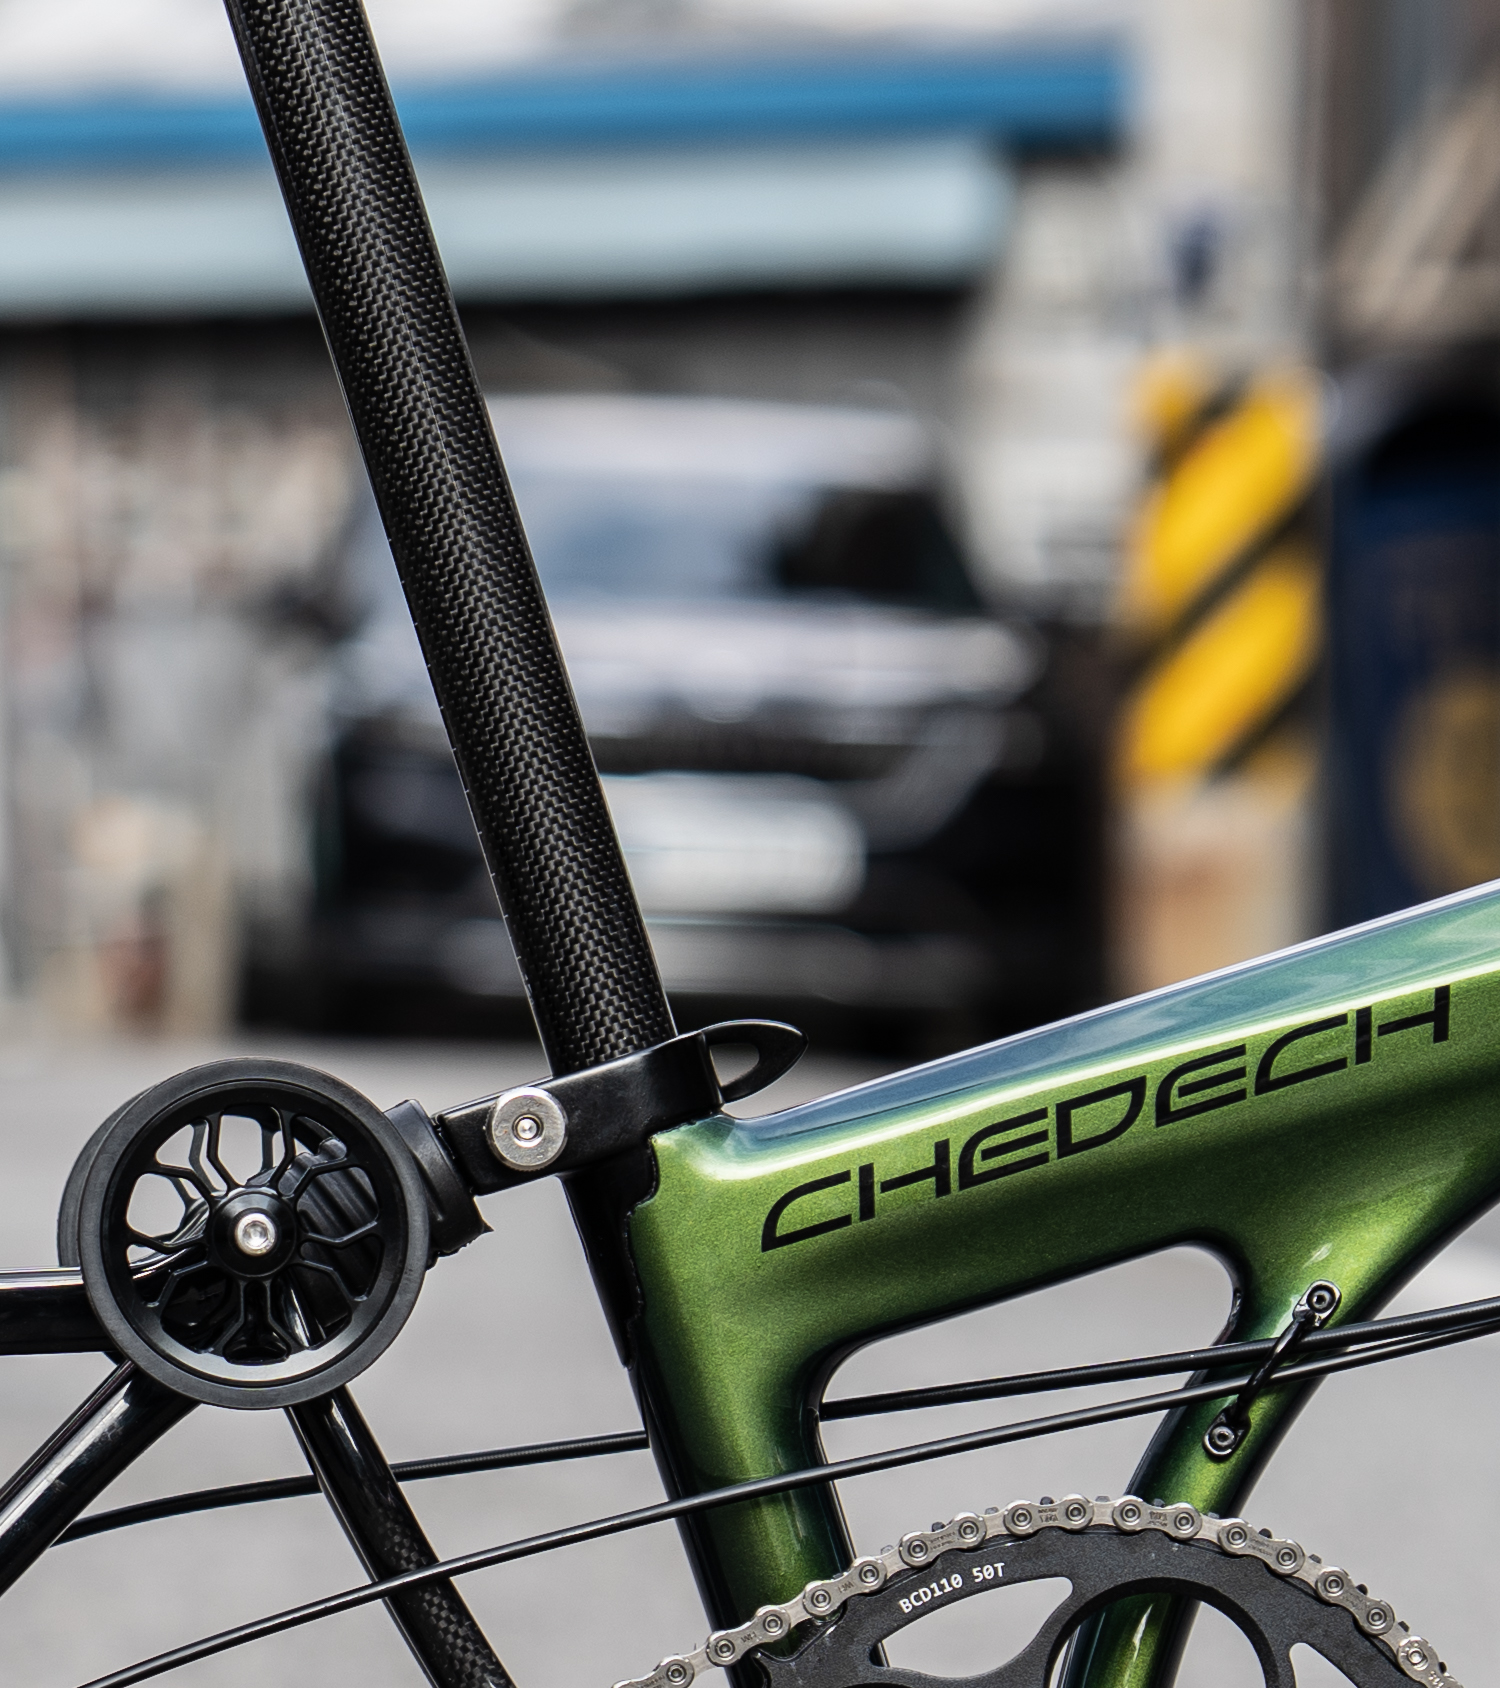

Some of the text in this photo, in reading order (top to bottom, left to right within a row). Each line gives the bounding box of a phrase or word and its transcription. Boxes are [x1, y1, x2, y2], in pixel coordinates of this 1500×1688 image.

[760, 984, 1451, 1252] CHEDECH
[898, 1562, 1006, 1614] BCD110 50T
